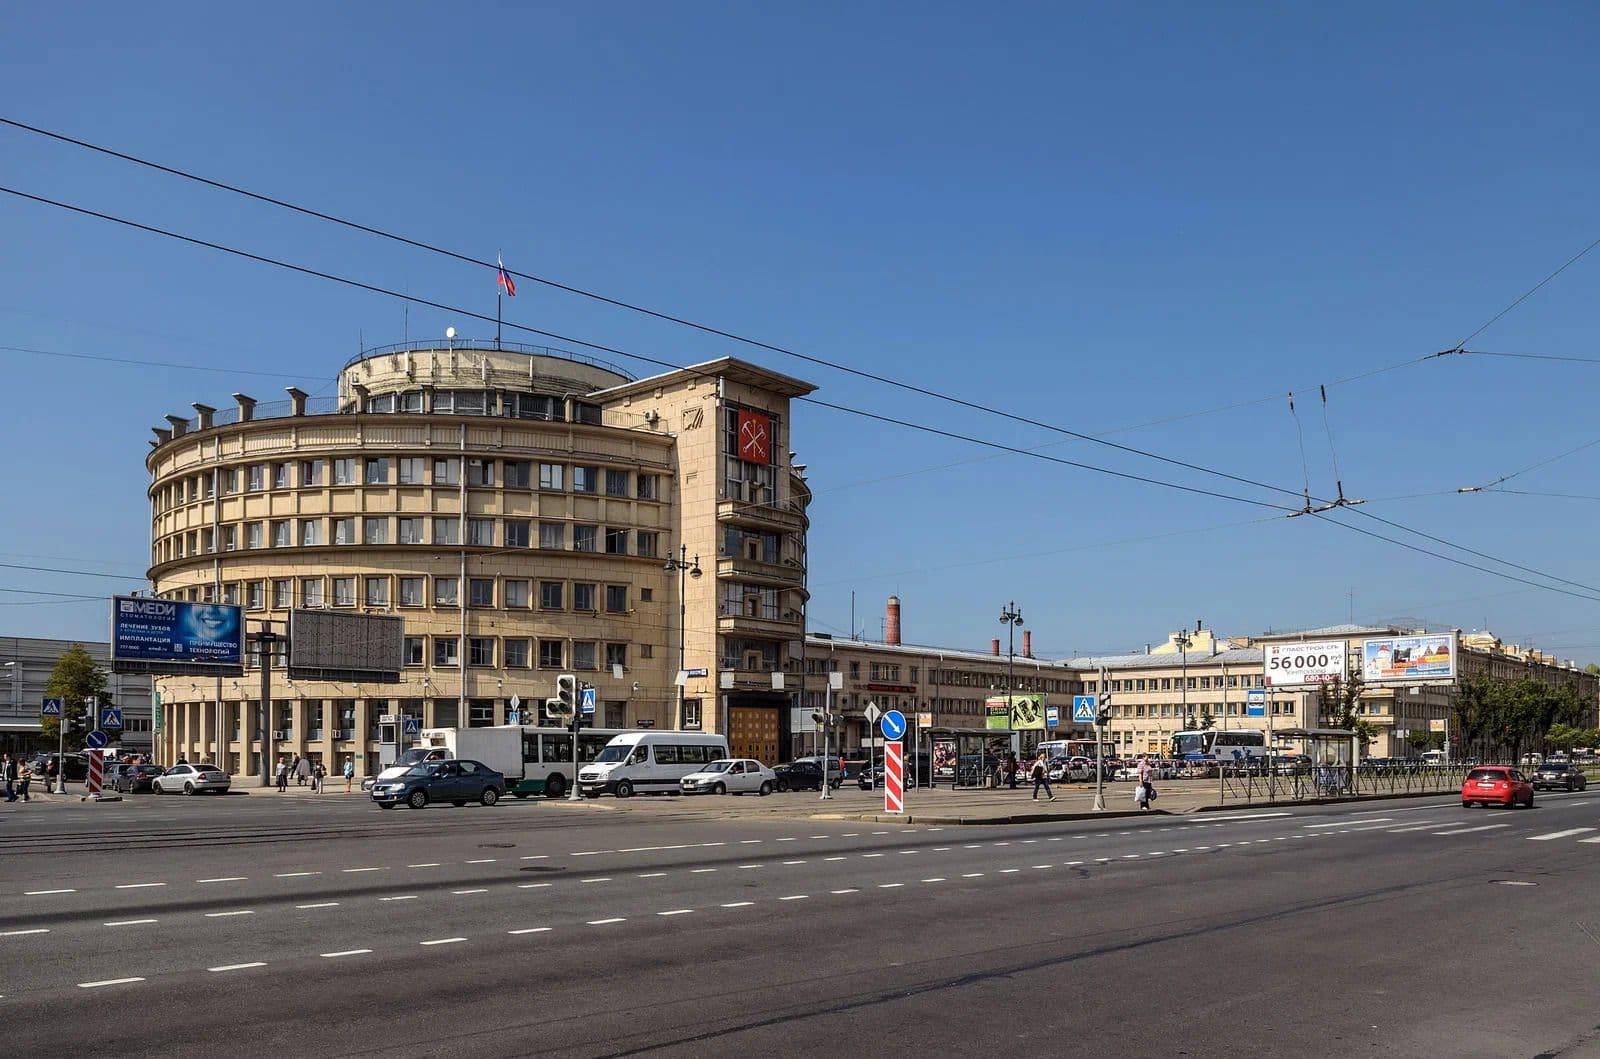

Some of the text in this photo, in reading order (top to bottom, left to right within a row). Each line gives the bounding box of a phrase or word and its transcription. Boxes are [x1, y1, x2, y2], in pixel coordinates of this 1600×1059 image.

[119, 635, 171, 644] ИМПЛАНТАЦИЯ
[189, 640, 238, 648] ПРЕИМУЩЕСТВО
[189, 647, 230, 655] ТЕХНОЛОГИЙ
